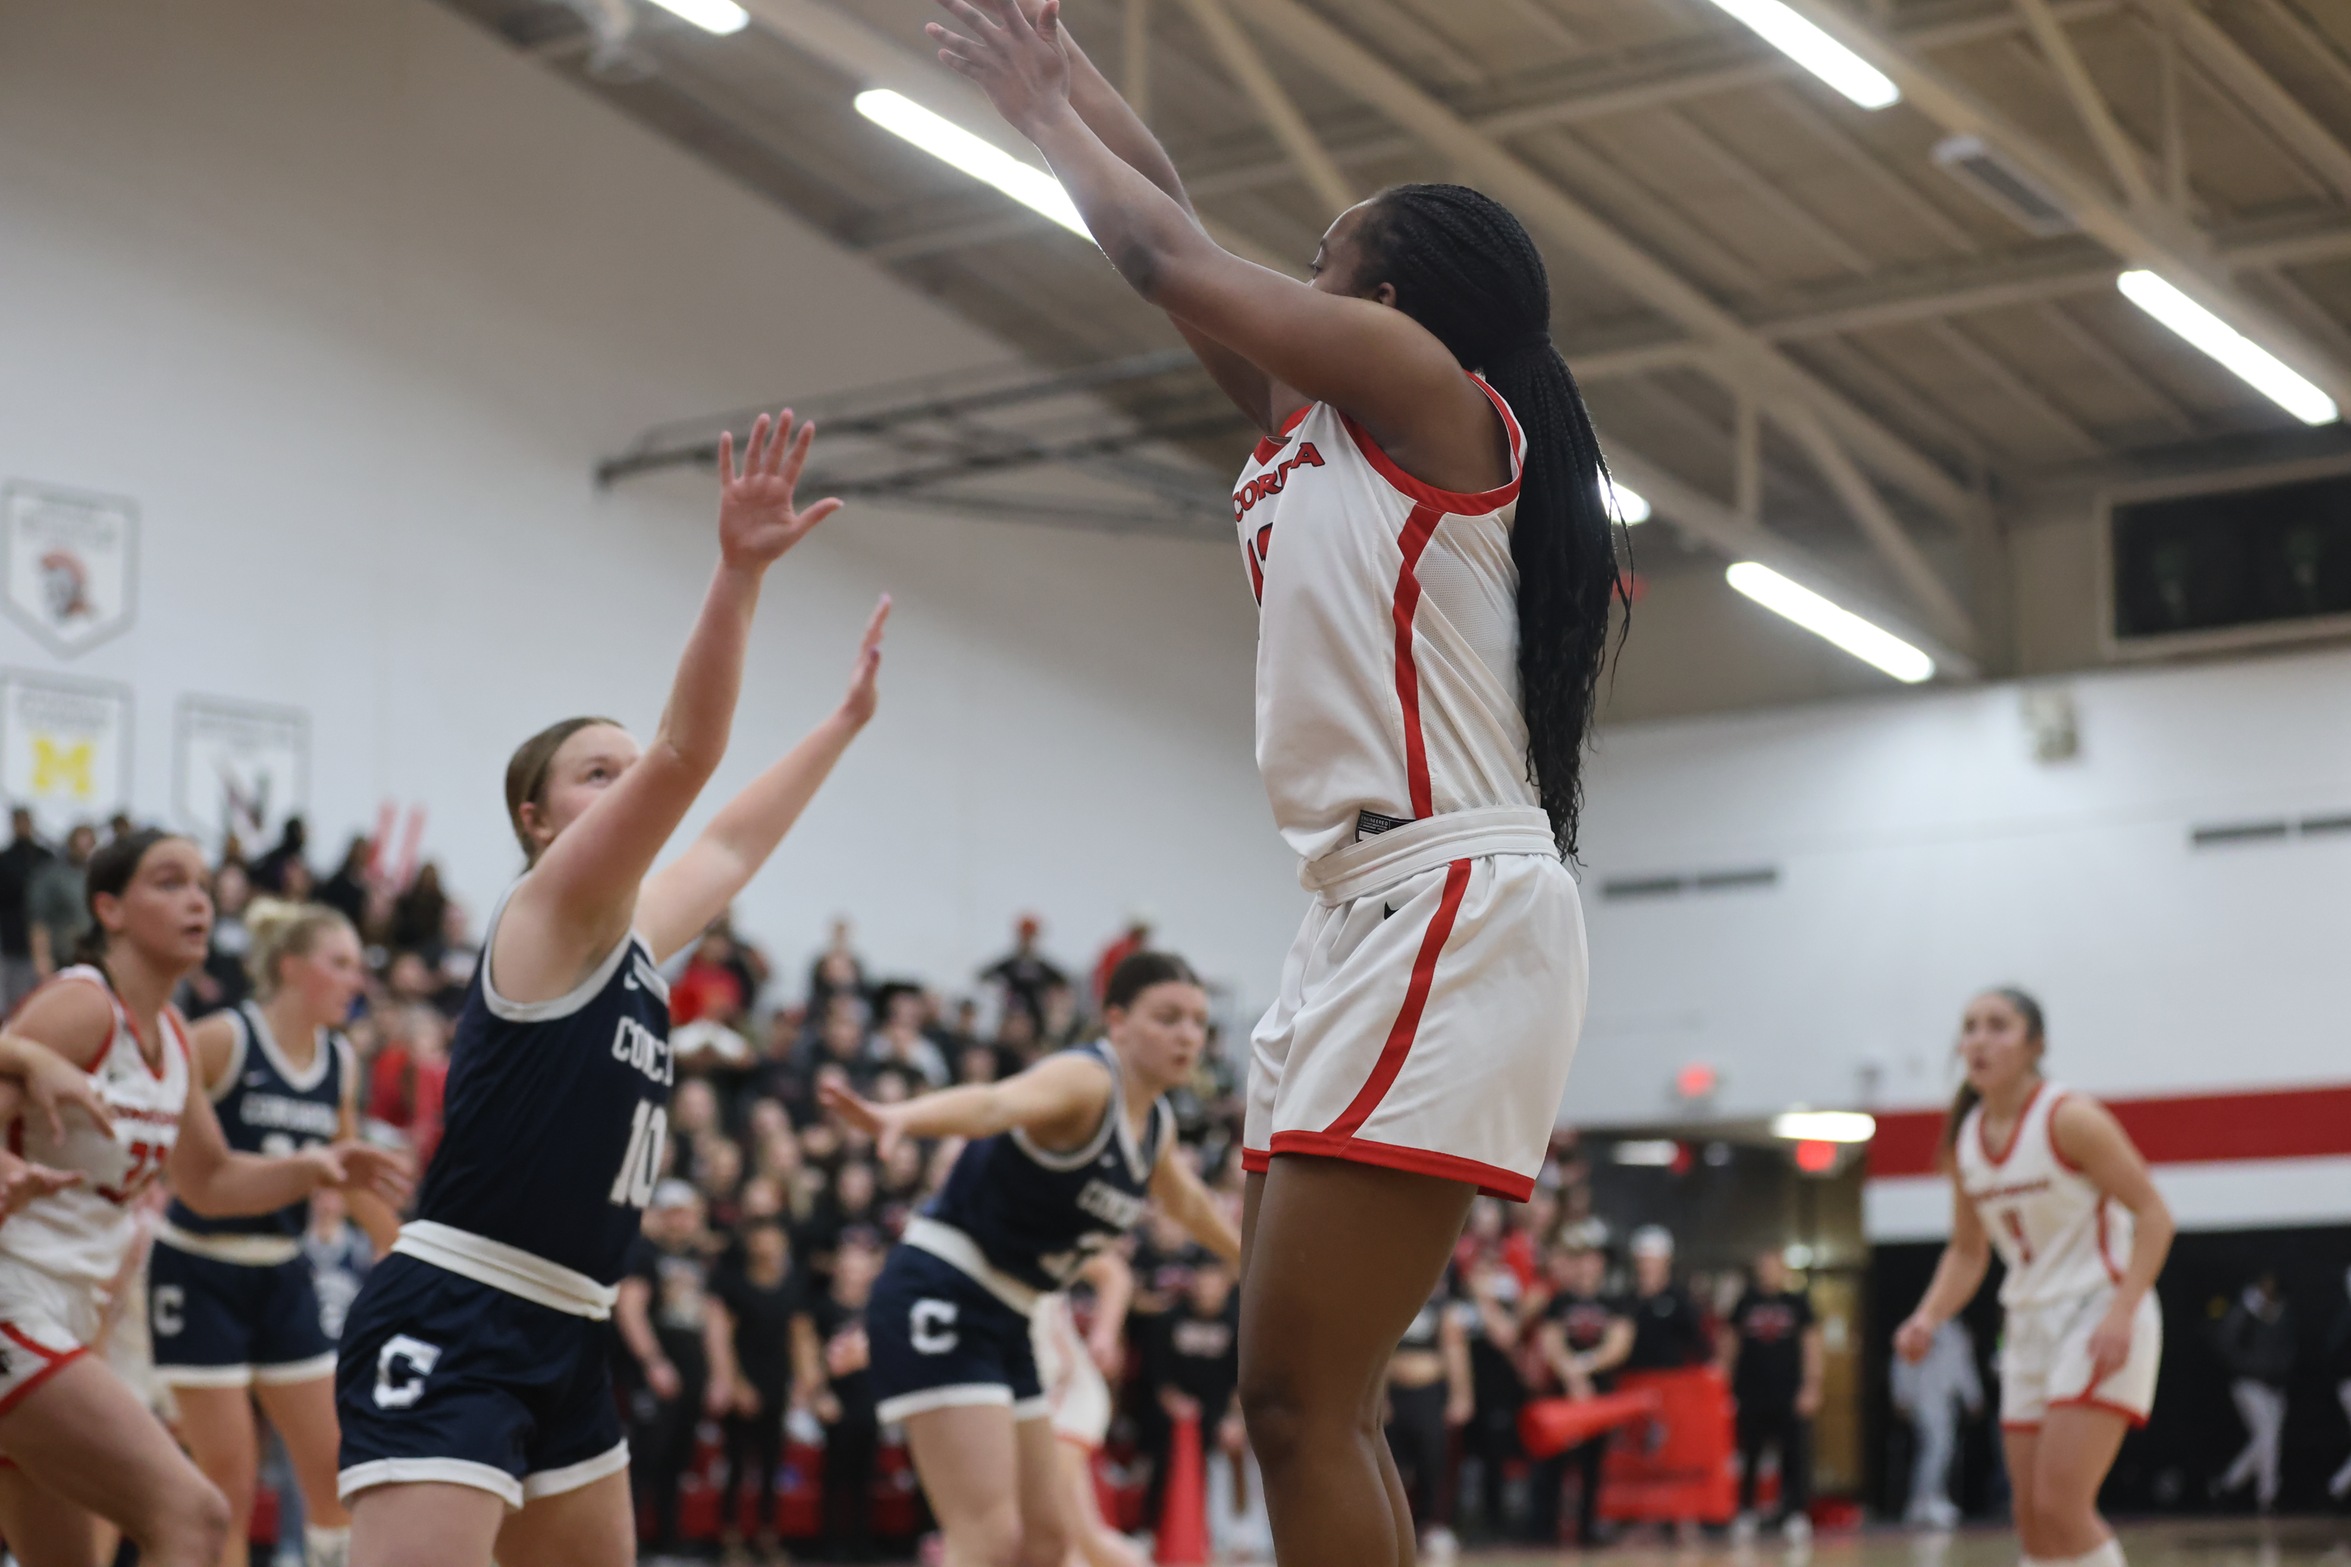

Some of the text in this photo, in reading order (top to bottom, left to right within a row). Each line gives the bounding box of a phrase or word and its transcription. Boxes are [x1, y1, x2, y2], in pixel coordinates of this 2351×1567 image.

[32, 738, 91, 795] M
[610, 1098, 668, 1207] 10
[154, 1284, 186, 1337] C
[909, 1297, 960, 1355] C
[371, 1333, 442, 1410] C
